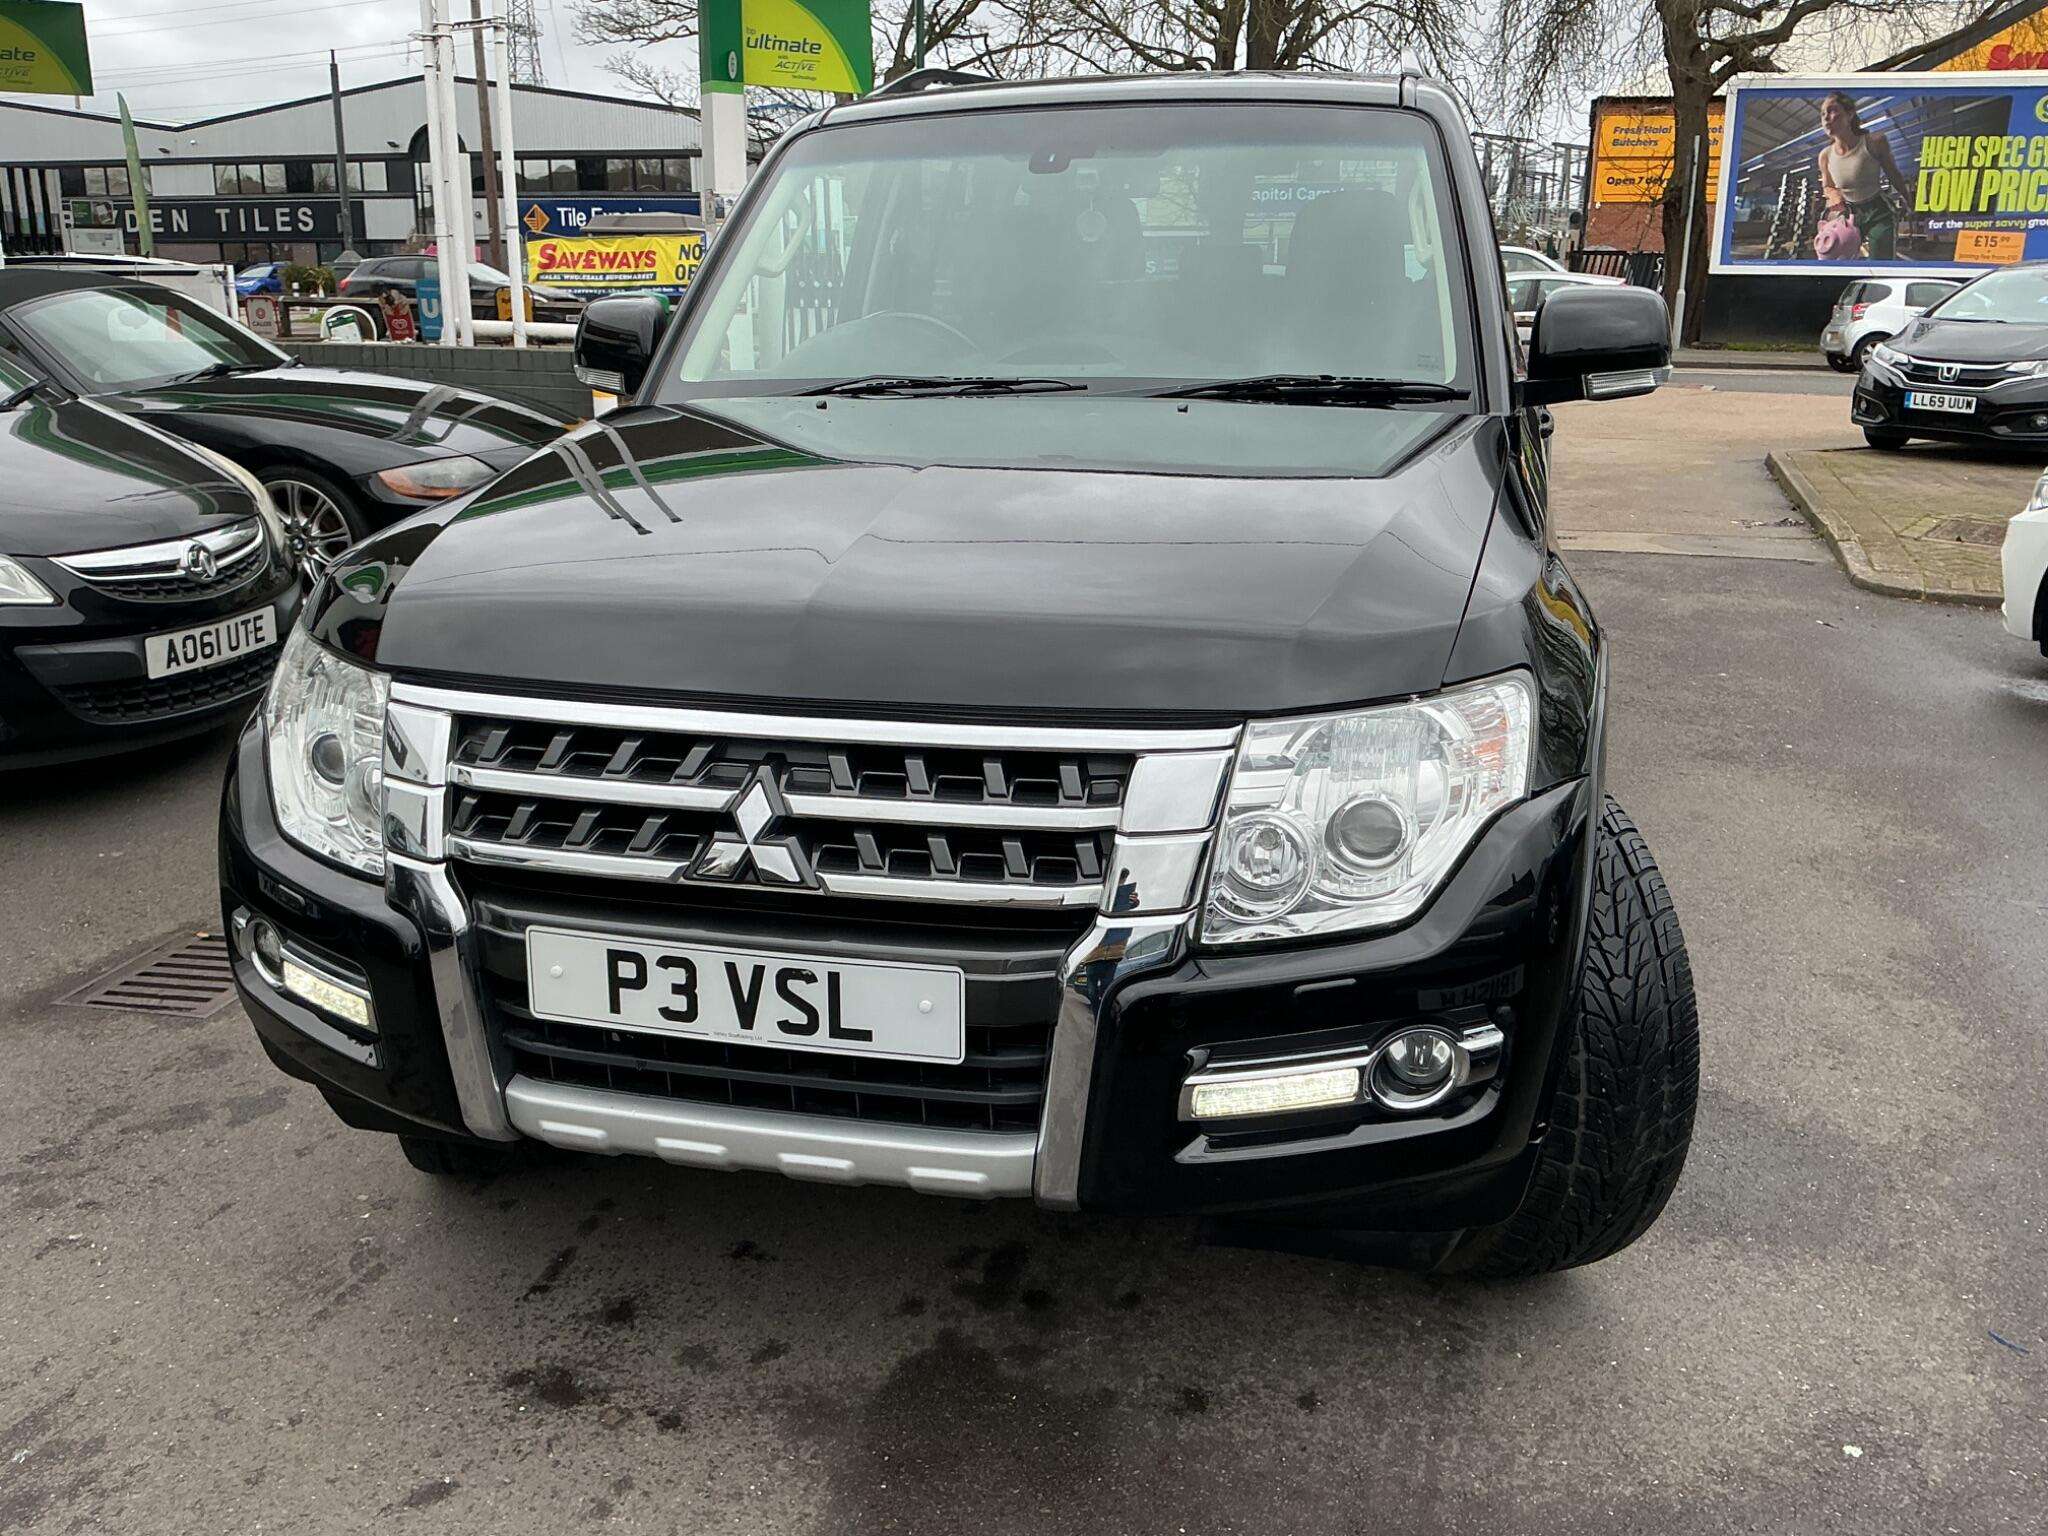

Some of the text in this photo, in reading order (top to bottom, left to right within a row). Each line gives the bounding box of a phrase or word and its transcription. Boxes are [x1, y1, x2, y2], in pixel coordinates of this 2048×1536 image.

[746, 33, 822, 55] ultimate
[775, 60, 817, 72] ACTIVE
[1920, 136, 1972, 168] HIGH
[1972, 135, 2027, 168] SPEC
[1606, 176, 1636, 187] Open
[1637, 176, 1645, 185] 7
[1914, 168, 2048, 212] LOW PRIC
[1252, 187, 1293, 201] apitol
[215, 207, 315, 233] TILES
[556, 207, 587, 227] Tile
[1928, 218, 2048, 230] for the super savvy gro
[563, 273, 604, 281] WHOLESALE
[605, 272, 655, 281] SUPERMARKET
[1912, 394, 1945, 408] LL69
[166, 614, 266, 669] AO61 UTE
[606, 948, 873, 1043] P3 VSL
